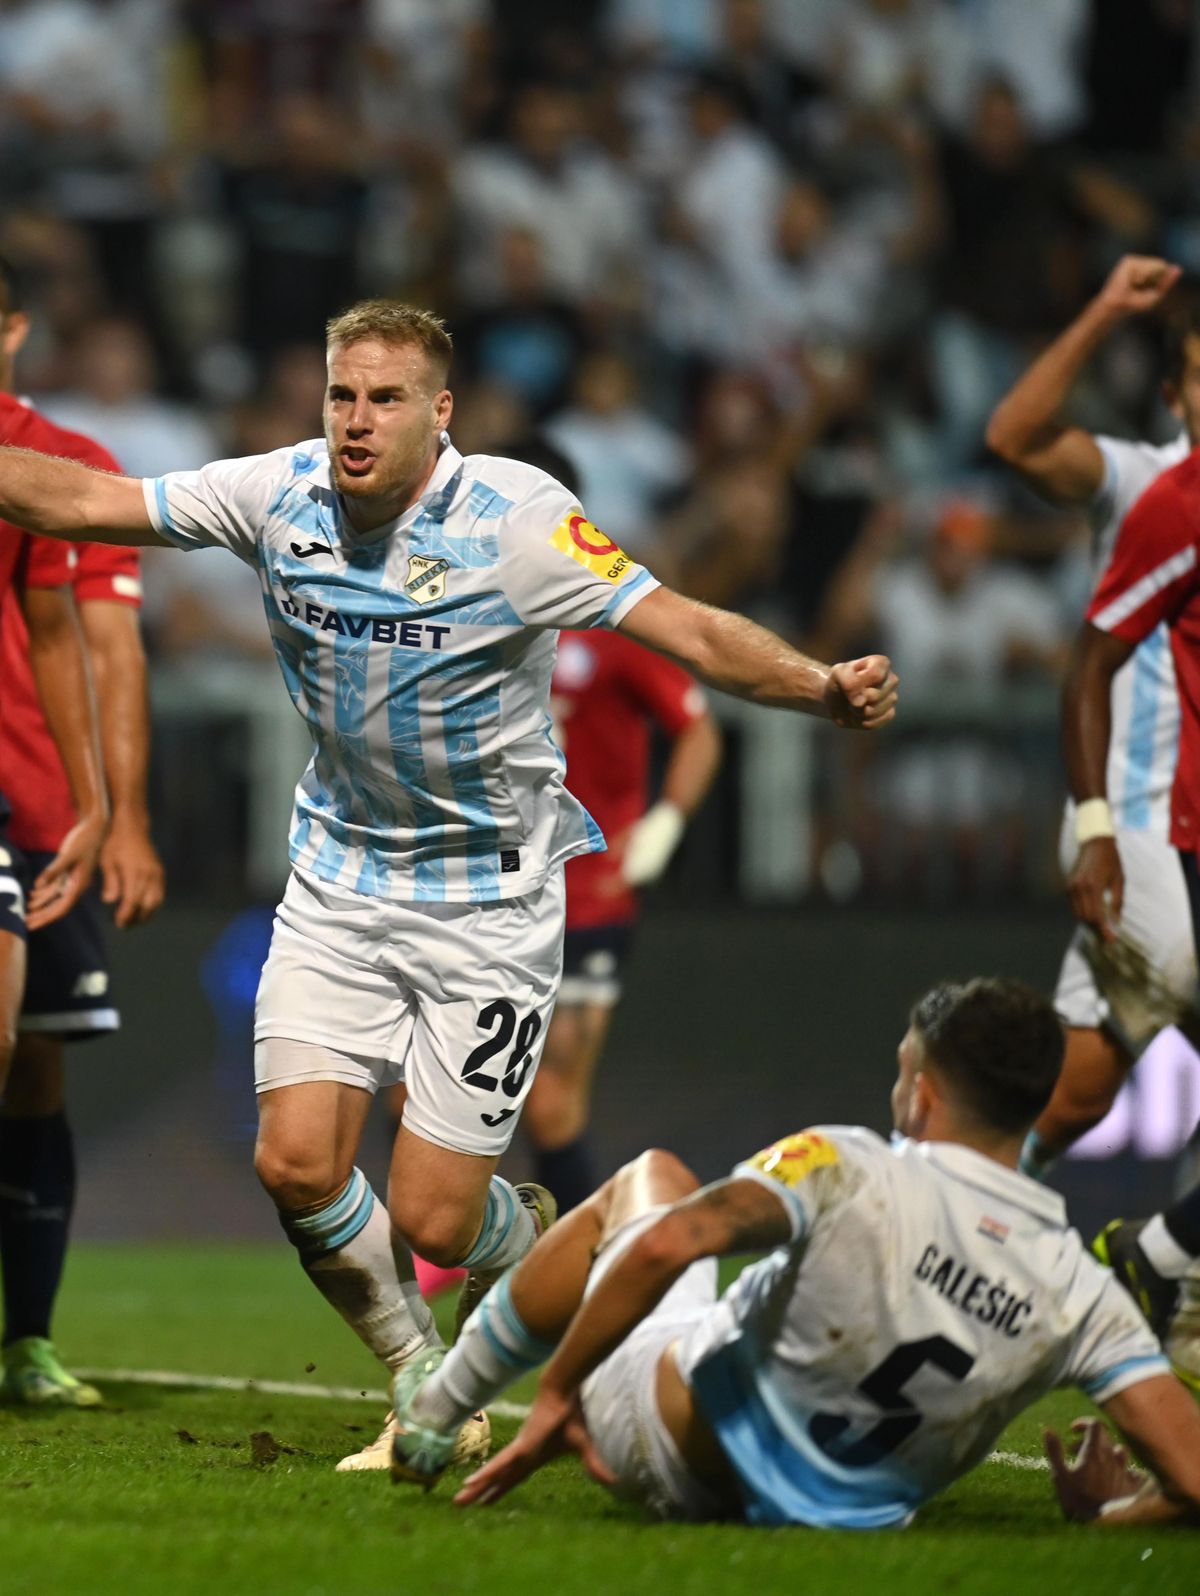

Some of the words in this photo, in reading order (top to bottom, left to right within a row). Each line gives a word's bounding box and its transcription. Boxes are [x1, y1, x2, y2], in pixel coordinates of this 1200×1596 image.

[412, 559, 430, 569] HNK
[305, 602, 451, 650] FAVBET
[459, 1000, 542, 1098] 28
[914, 1244, 1033, 1338] GALEŠIĆ
[808, 1335, 975, 1468] 5
